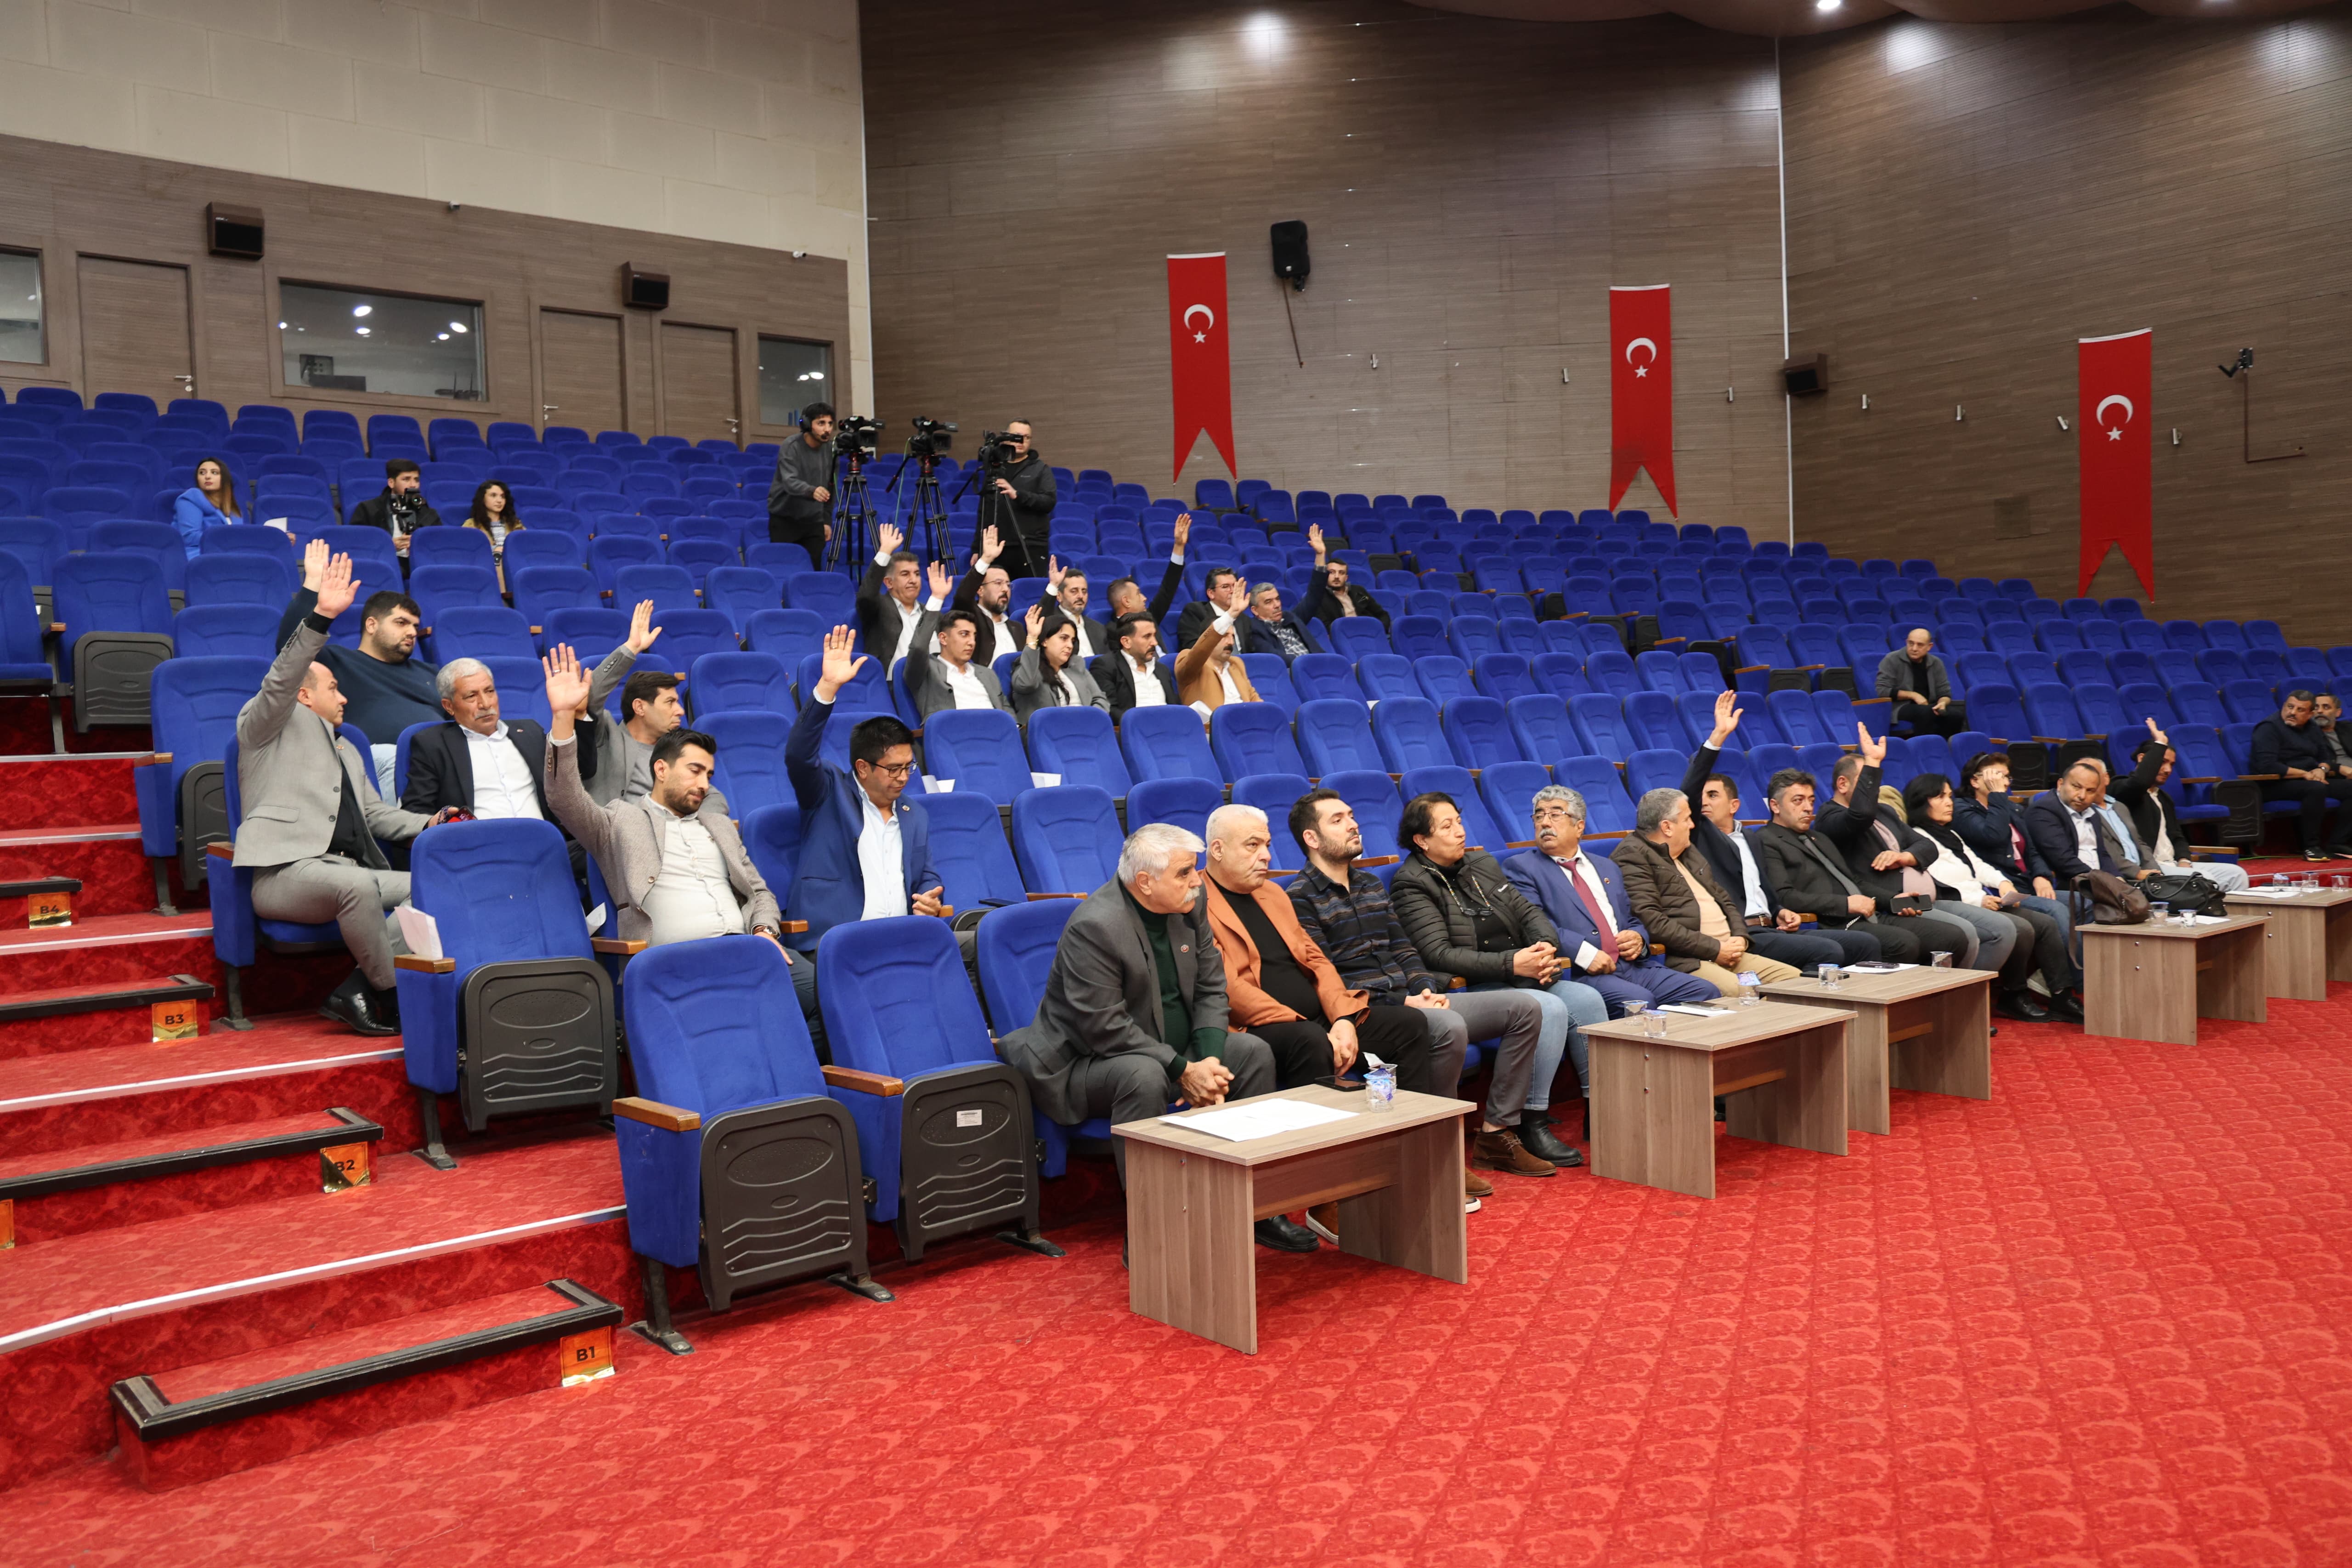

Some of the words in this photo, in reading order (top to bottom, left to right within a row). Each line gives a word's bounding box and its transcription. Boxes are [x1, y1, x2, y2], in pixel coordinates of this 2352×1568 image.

[40, 905, 59, 914] B4
[165, 1014, 184, 1025] B3
[334, 1160, 355, 1172] B2
[577, 1346, 595, 1362] B1
